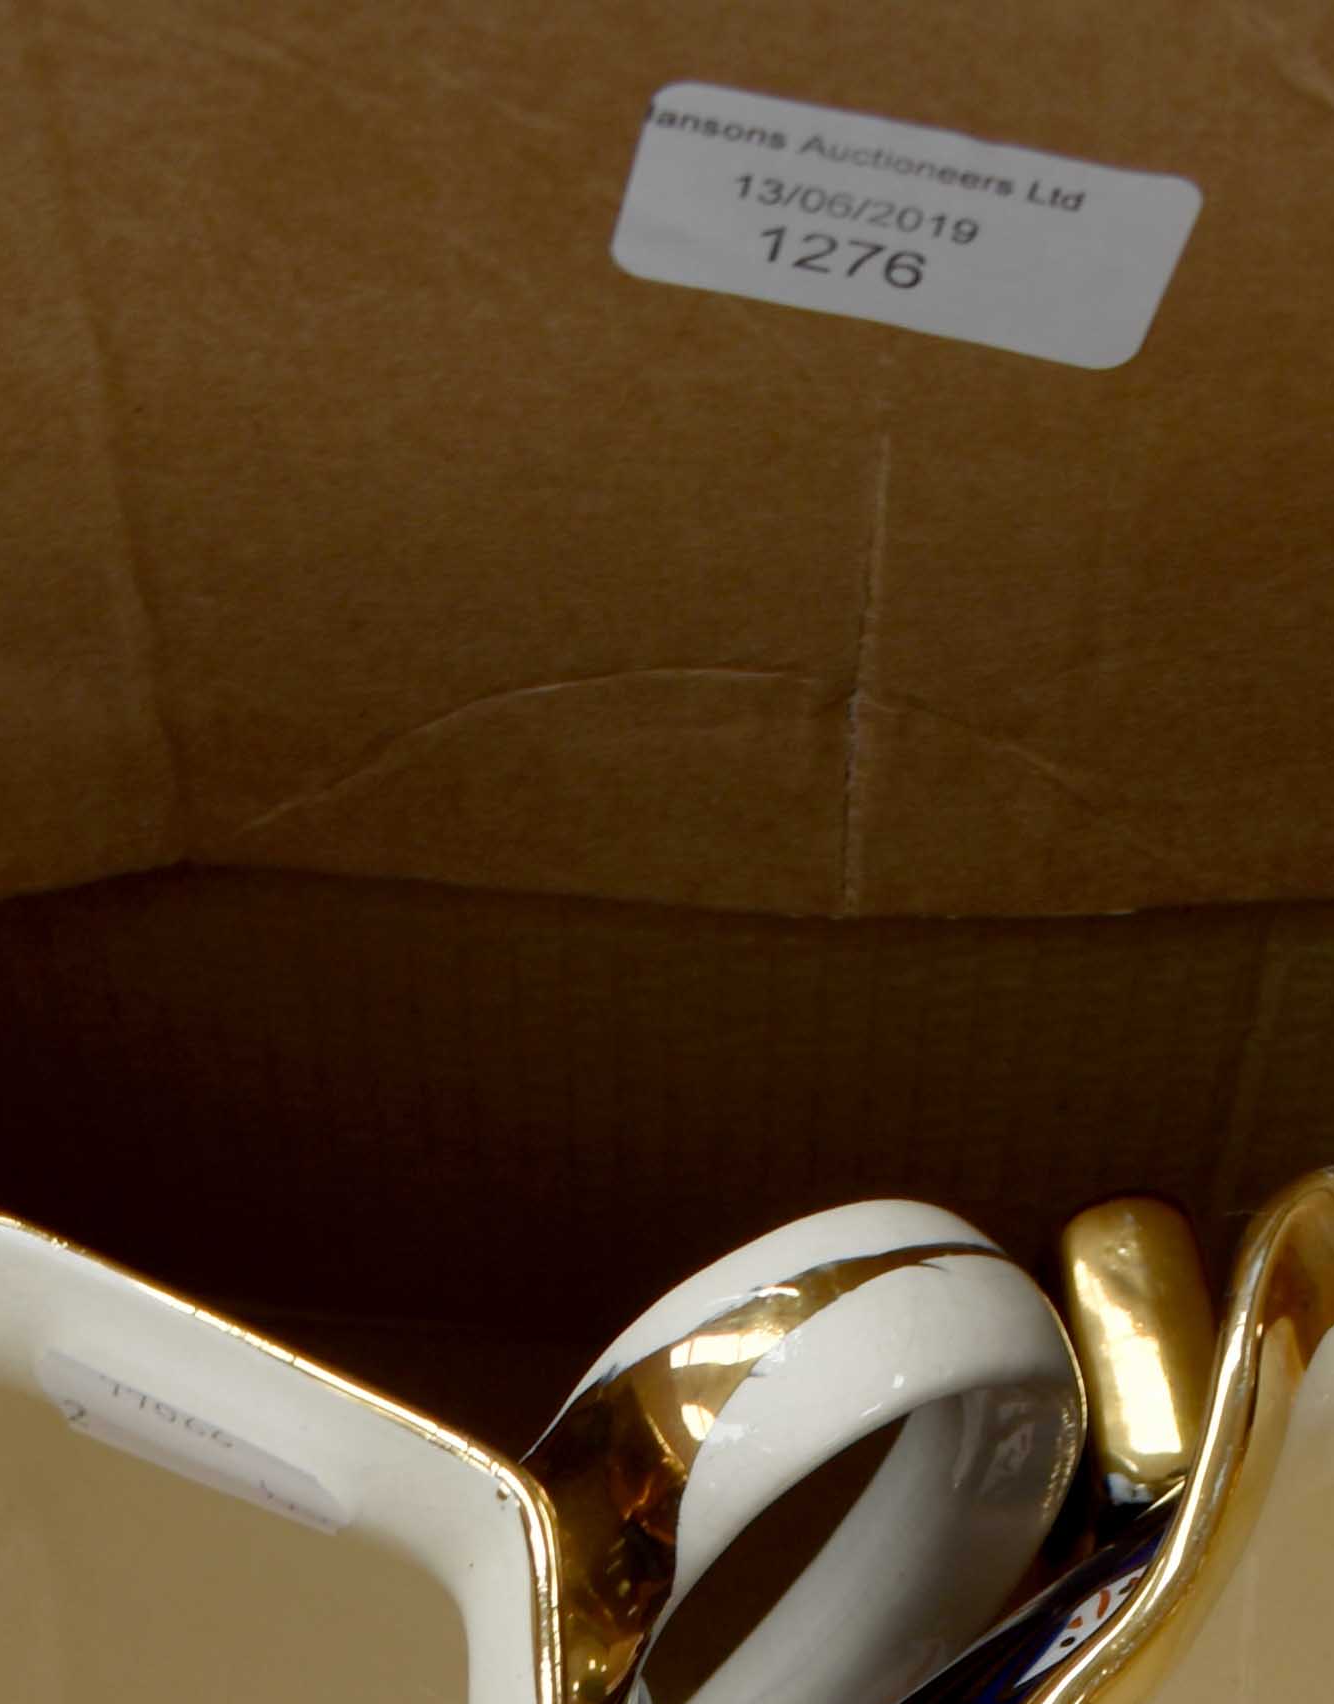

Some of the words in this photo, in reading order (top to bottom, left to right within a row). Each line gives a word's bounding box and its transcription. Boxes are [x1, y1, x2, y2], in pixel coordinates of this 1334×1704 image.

[734, 173, 981, 246] 13/06/2019
[797, 135, 1015, 196] Auctioneers
[1025, 179, 1086, 213] Ltd
[759, 226, 928, 290] 1276
